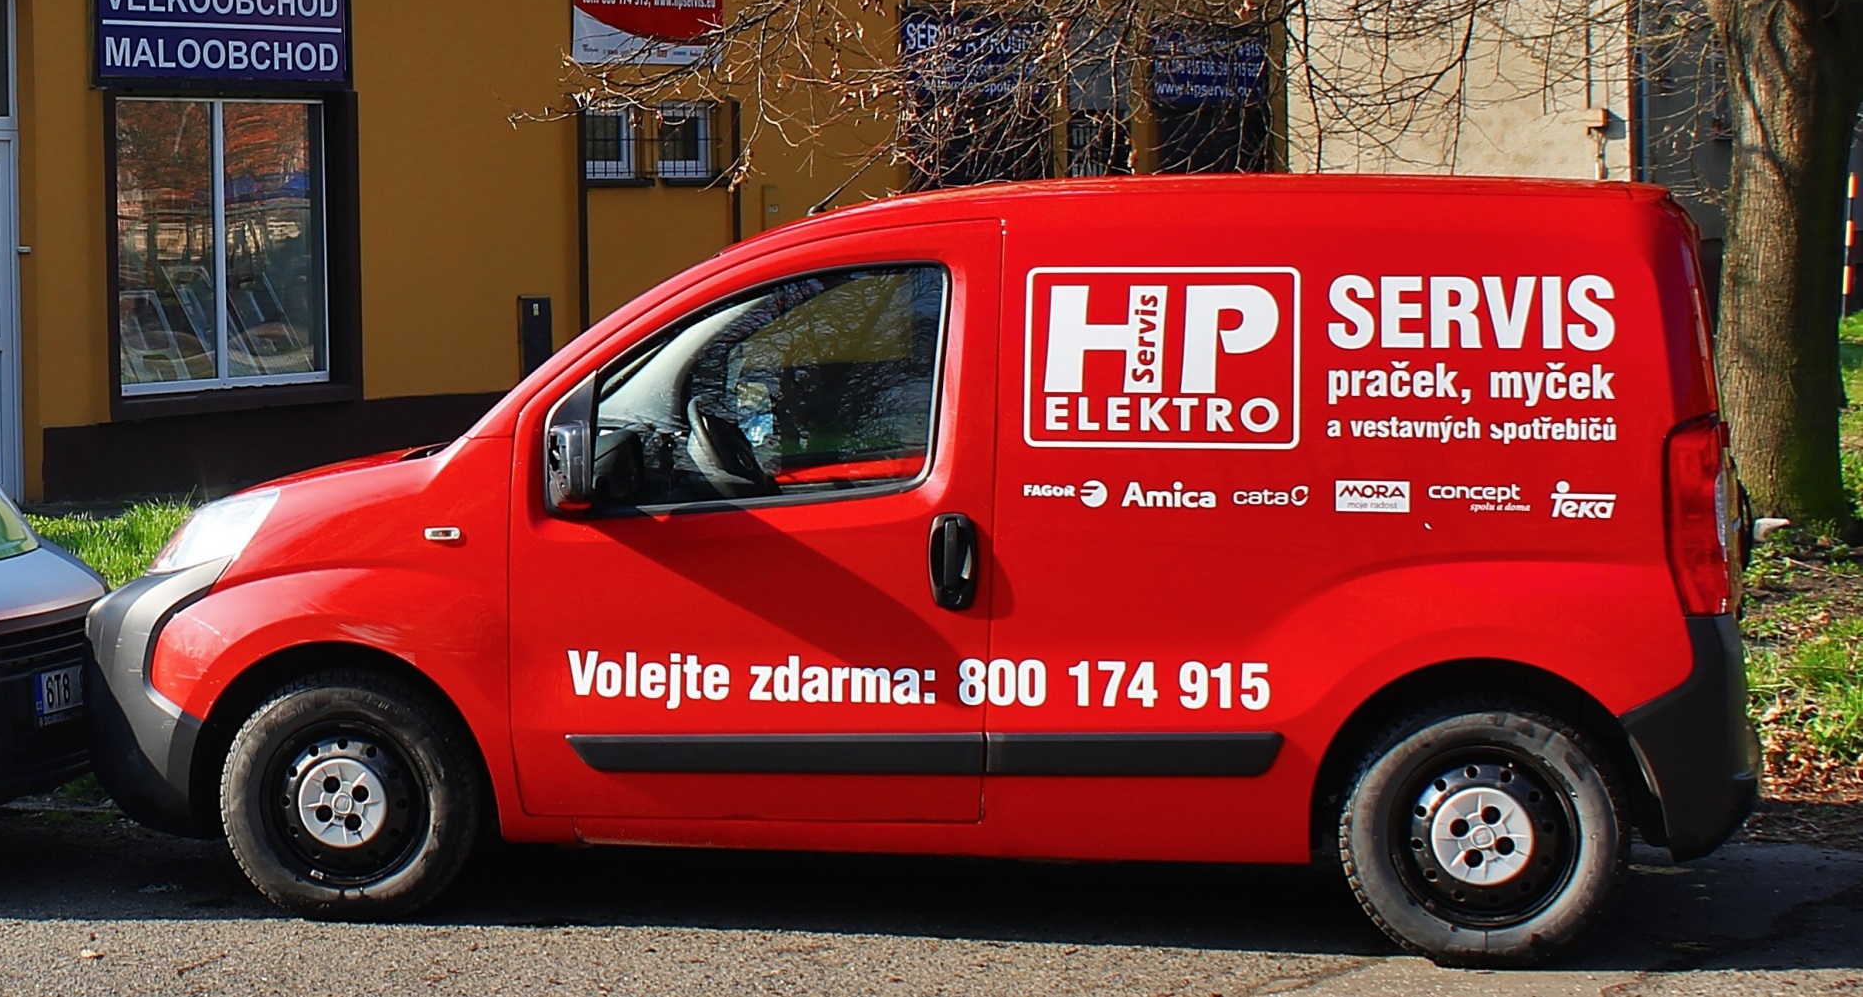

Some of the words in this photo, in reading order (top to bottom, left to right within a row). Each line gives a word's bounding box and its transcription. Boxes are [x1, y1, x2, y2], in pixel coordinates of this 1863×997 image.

[104, 36, 338, 71] MALOOBCHOD
[1328, 274, 1617, 351] SERVIS
[1044, 284, 1279, 394] HP
[1131, 293, 1159, 384] Servis
[1328, 360, 1472, 405] praček,
[1490, 361, 1615, 407] myček
[1044, 396, 1280, 433] ELEKTRO
[1327, 420, 1342, 438] a
[1351, 415, 1481, 444] vestavných
[1490, 416, 1617, 445] spotřebičů
[1023, 484, 1076, 497] FAGOR
[1121, 481, 1217, 508] Amica
[1233, 488, 1288, 506] cata
[1338, 485, 1406, 499] MORA
[1347, 501, 1368, 510] moje
[1370, 501, 1398, 510] radost
[1428, 484, 1521, 502] concept
[1550, 492, 1617, 519] Teka
[1470, 502, 1494, 512] spolu
[1505, 503, 1531, 512] doma
[46, 673, 71, 709] 6T8
[568, 650, 731, 711] Volejte
[750, 655, 936, 705] zdarma:
[958, 658, 1047, 707] 800
[1068, 660, 1158, 709] 174
[1179, 661, 1270, 711] 915
